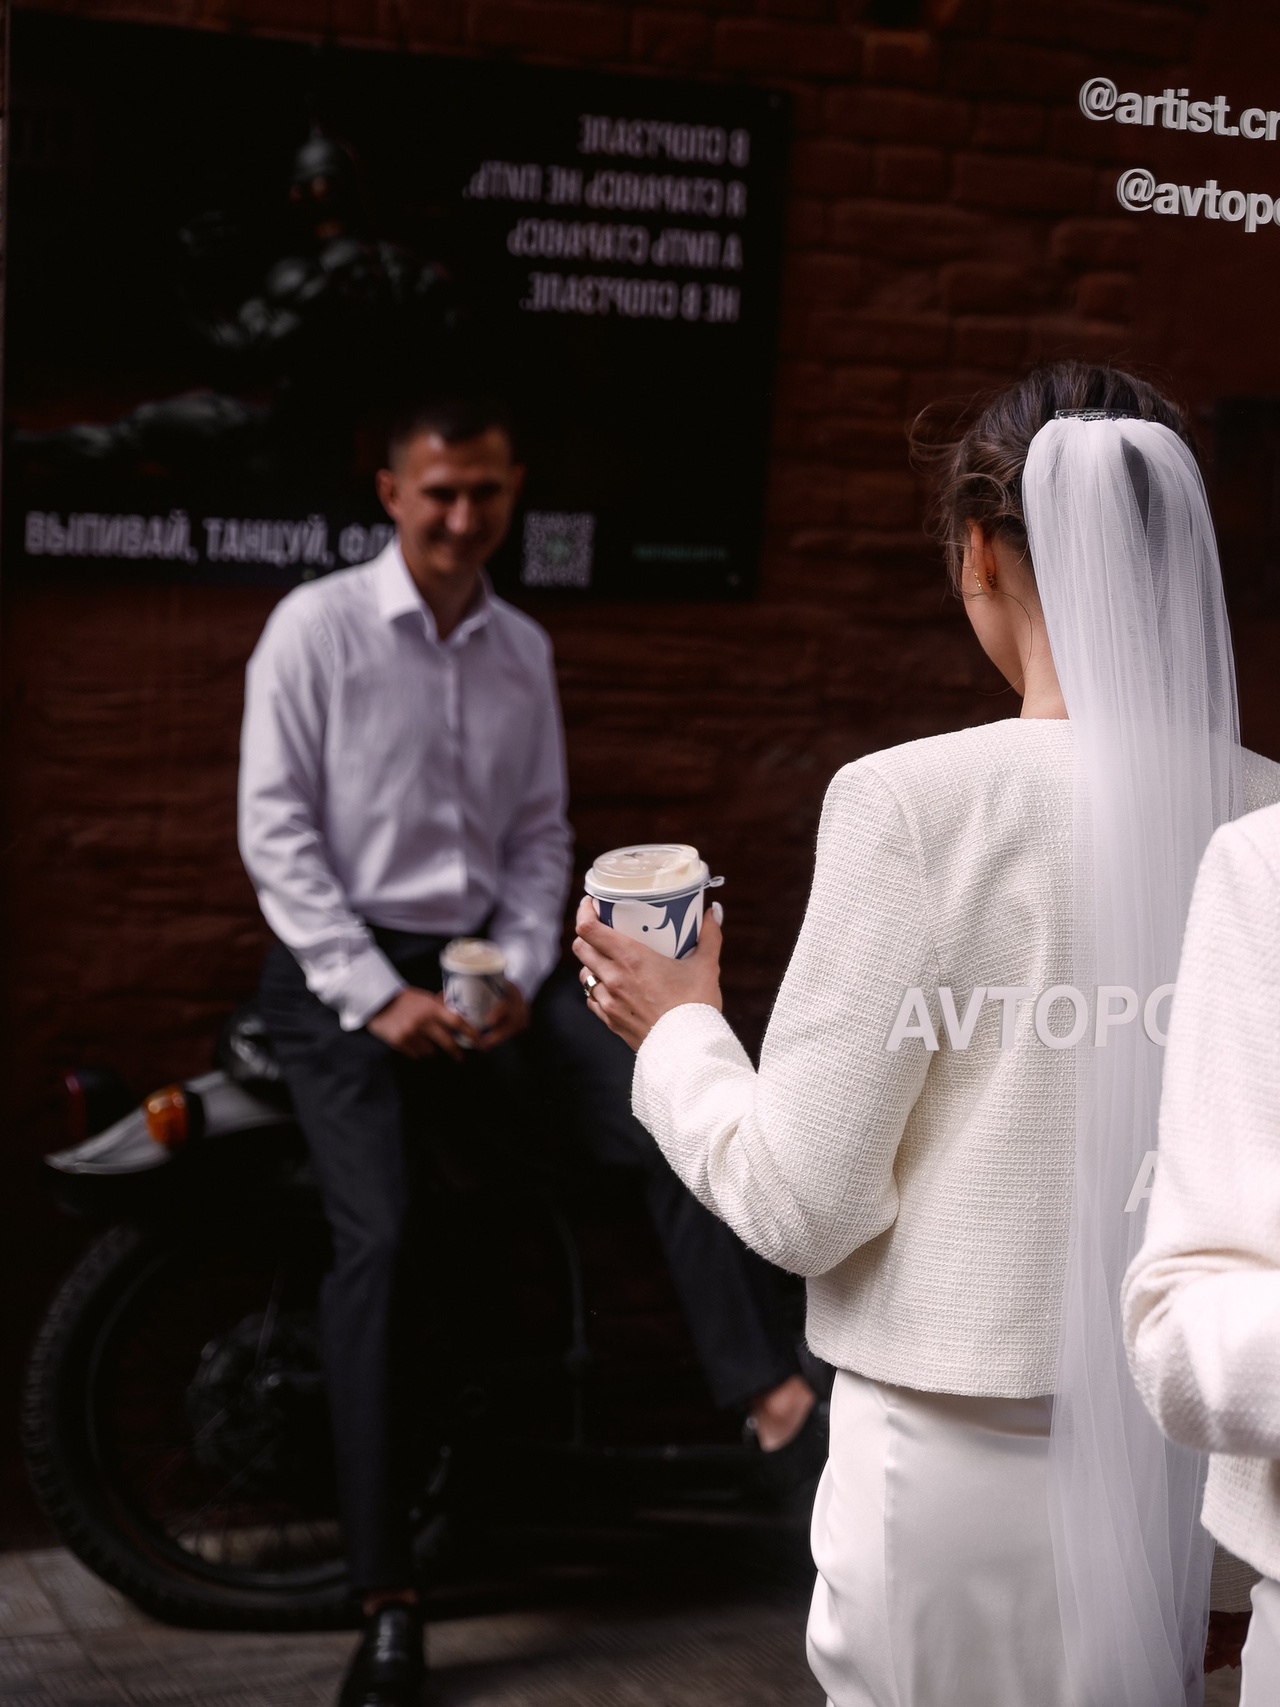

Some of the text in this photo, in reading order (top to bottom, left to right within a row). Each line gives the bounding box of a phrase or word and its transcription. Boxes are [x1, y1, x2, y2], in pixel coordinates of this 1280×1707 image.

[25, 509, 395, 568] ВЫПИВАЙ, ТАНЦУЙ, ФЛ
